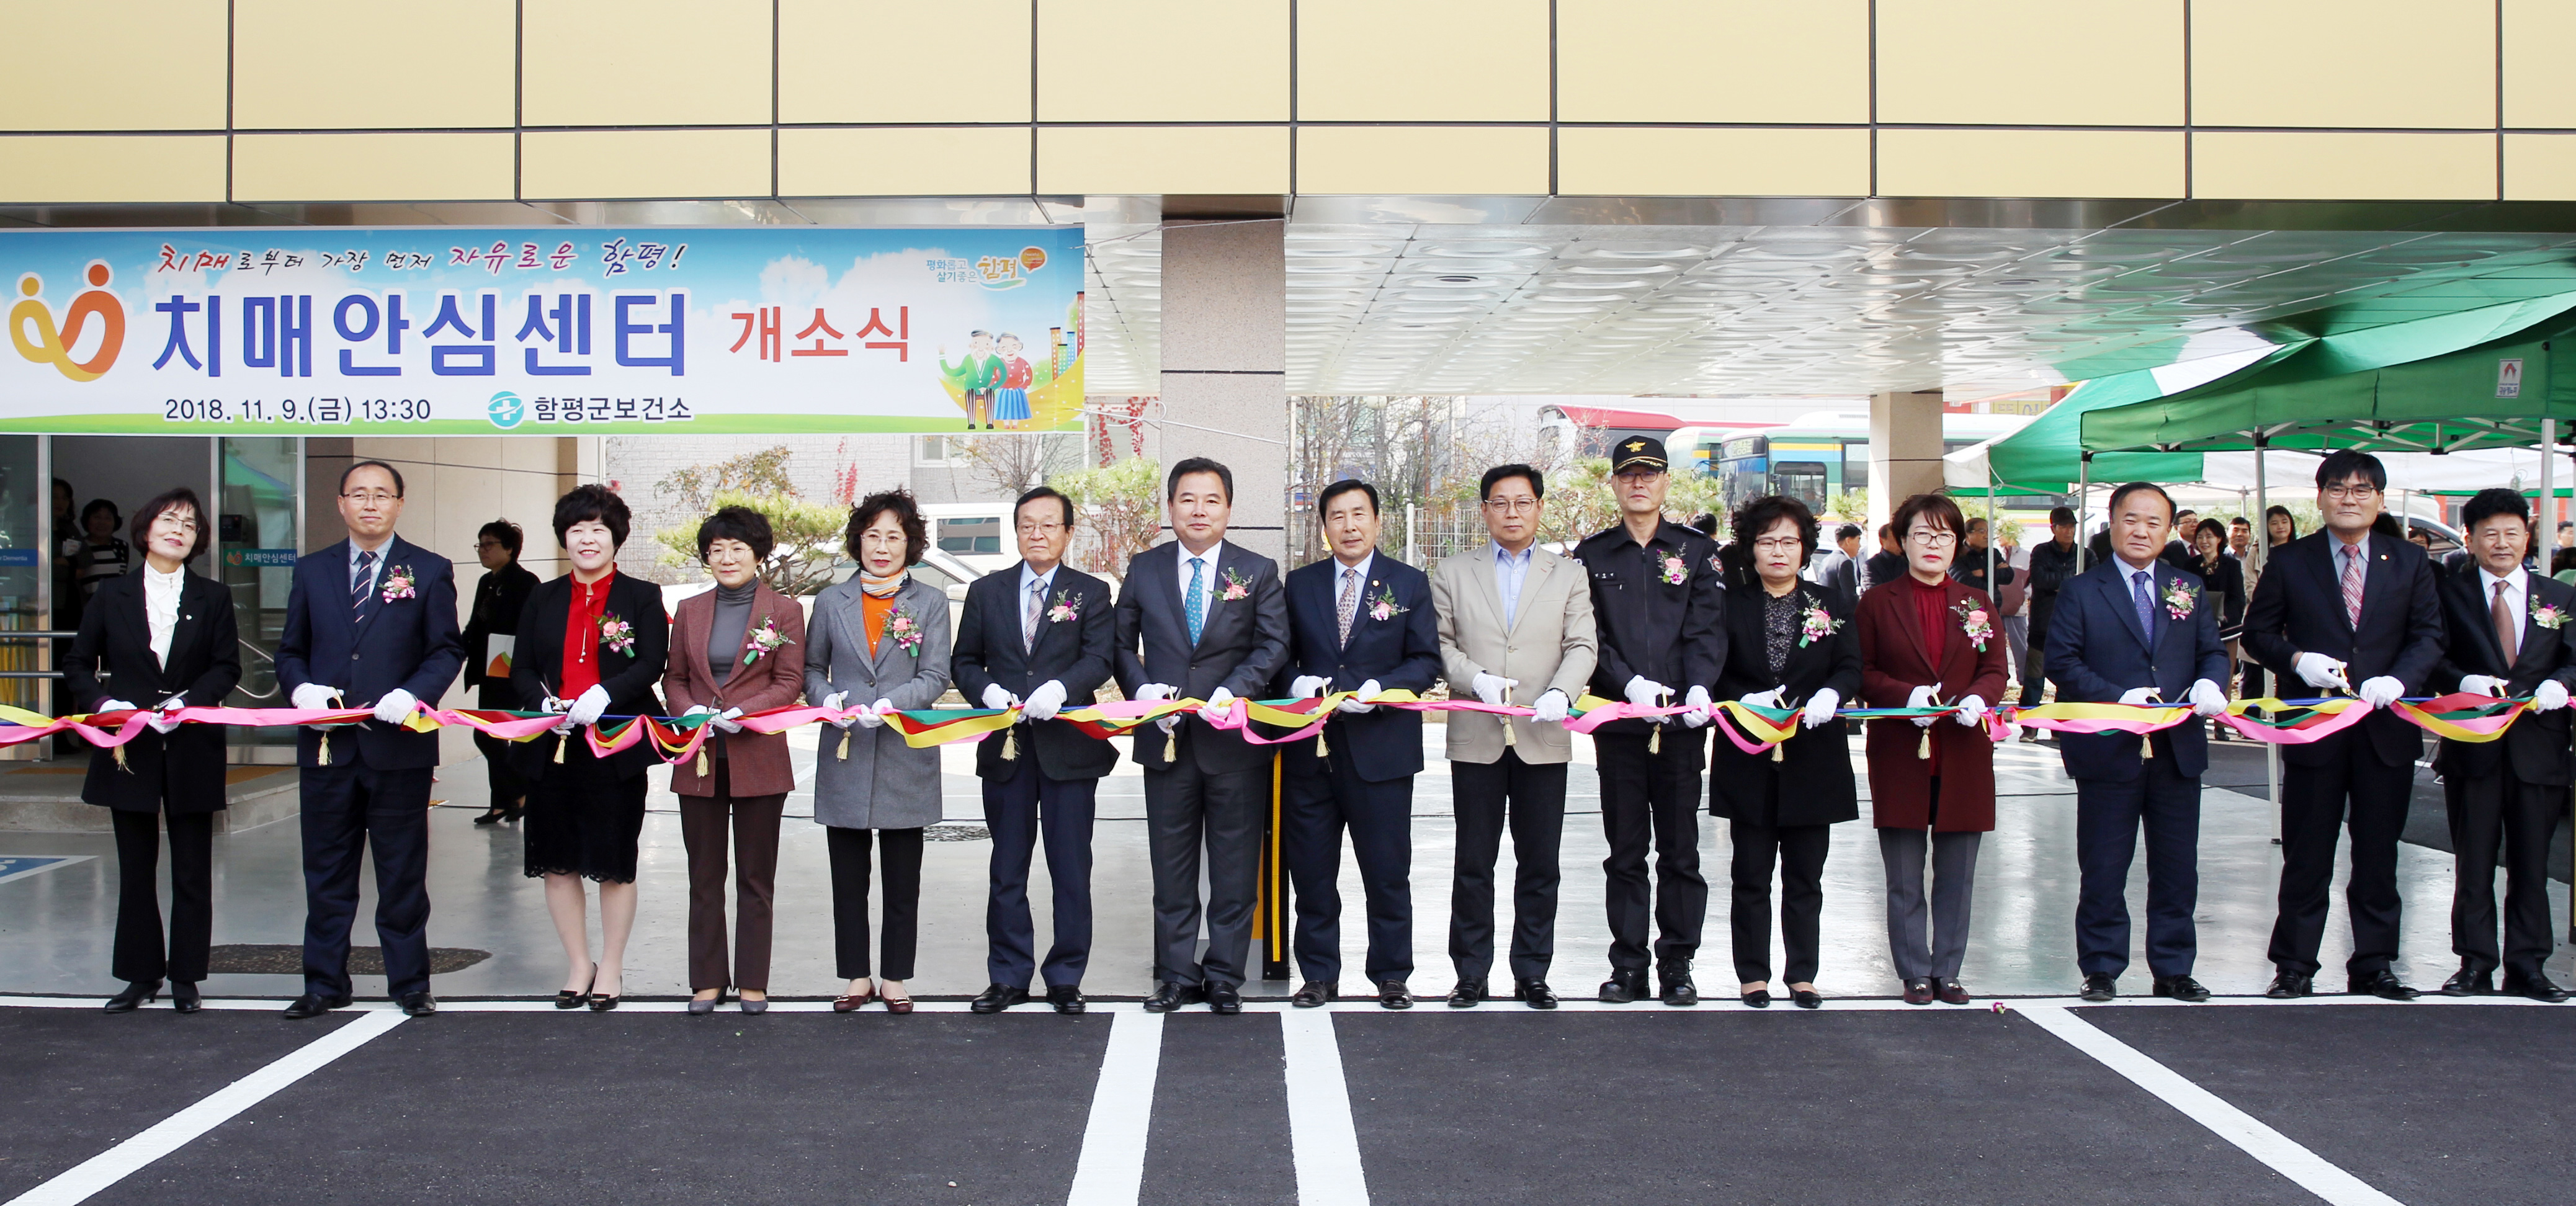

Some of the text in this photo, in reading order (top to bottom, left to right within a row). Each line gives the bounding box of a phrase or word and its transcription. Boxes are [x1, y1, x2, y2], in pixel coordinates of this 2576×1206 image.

[321, 251, 370, 271] 가장
[385, 252, 432, 269] 먼저
[450, 242, 577, 274] 자유로운
[604, 239, 686, 277] 함평!
[926, 259, 967, 270] 평화롭고
[978, 258, 1016, 279] 함평
[936, 271, 978, 283] 살기좋은
[152, 293, 909, 377] 치매안심센터 개소식
[165, 399, 231, 421] 2018.
[241, 399, 272, 421] 11.
[362, 399, 431, 420] 13:30
[534, 397, 692, 421] 함평군보건소
[244, 553, 297, 563] 치매안심센터
